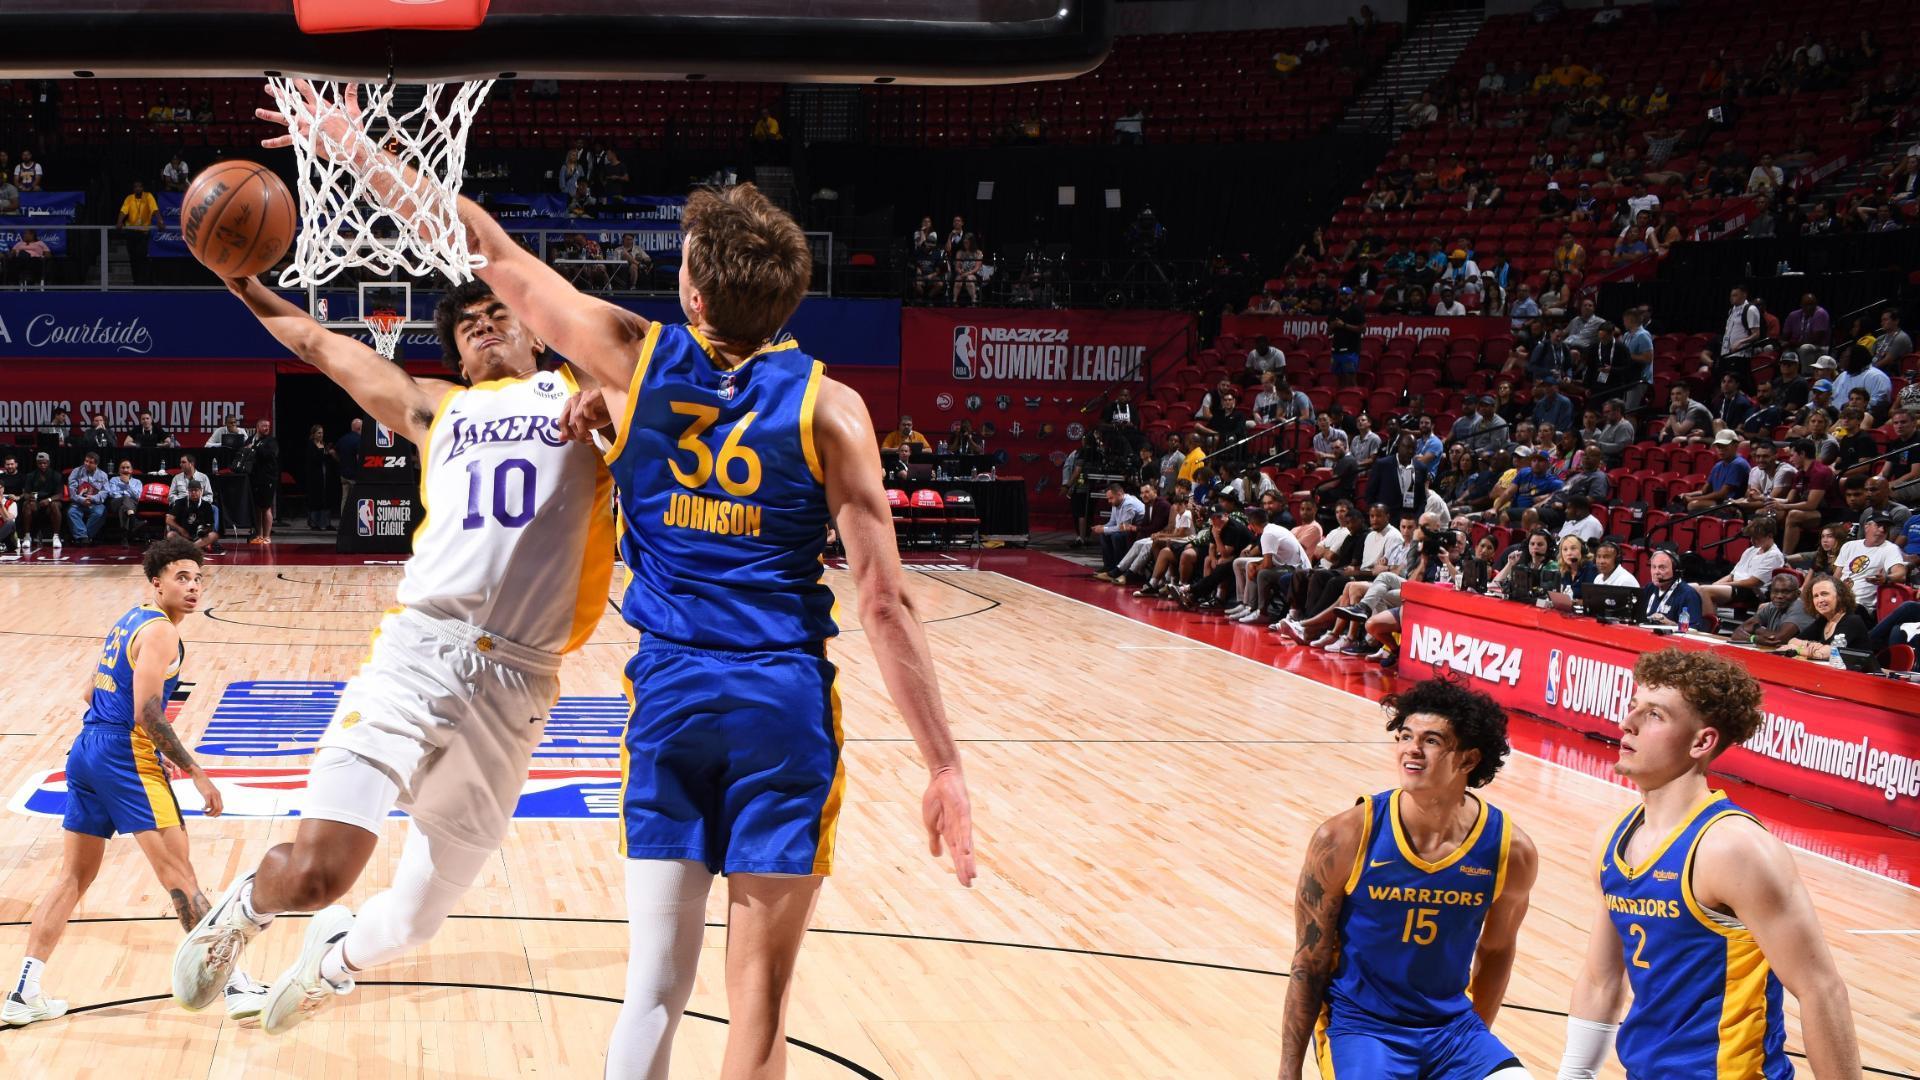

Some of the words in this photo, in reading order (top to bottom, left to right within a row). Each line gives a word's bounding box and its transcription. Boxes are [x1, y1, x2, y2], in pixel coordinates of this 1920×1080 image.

[185, 182, 229, 247] Wilson
[26, 313, 153, 353] Courtside
[981, 327, 1069, 342] NBA2K24
[980, 343, 1069, 380] SUMMER
[1072, 345, 1146, 382] LEAGUE
[149, 400, 193, 433] PLAY
[443, 415, 568, 466] LAKERS
[667, 400, 762, 497] 36
[363, 456, 406, 468] 2K24
[377, 506, 411, 521] SUMMER
[463, 458, 537, 530] 10
[376, 521, 406, 536] LEAGUE
[663, 492, 762, 537] JOHNSON
[1409, 623, 1523, 686] NBA2K24
[1562, 654, 1636, 724] SUMMER
[1742, 710, 1920, 801] BA2KSummerLeague
[1460, 865, 1491, 876] Rakuten
[1368, 885, 1484, 906] WARRIORS
[1605, 893, 1681, 918] WARRIORS
[1401, 908, 1440, 946] 15
[1629, 923, 1650, 969] 2
